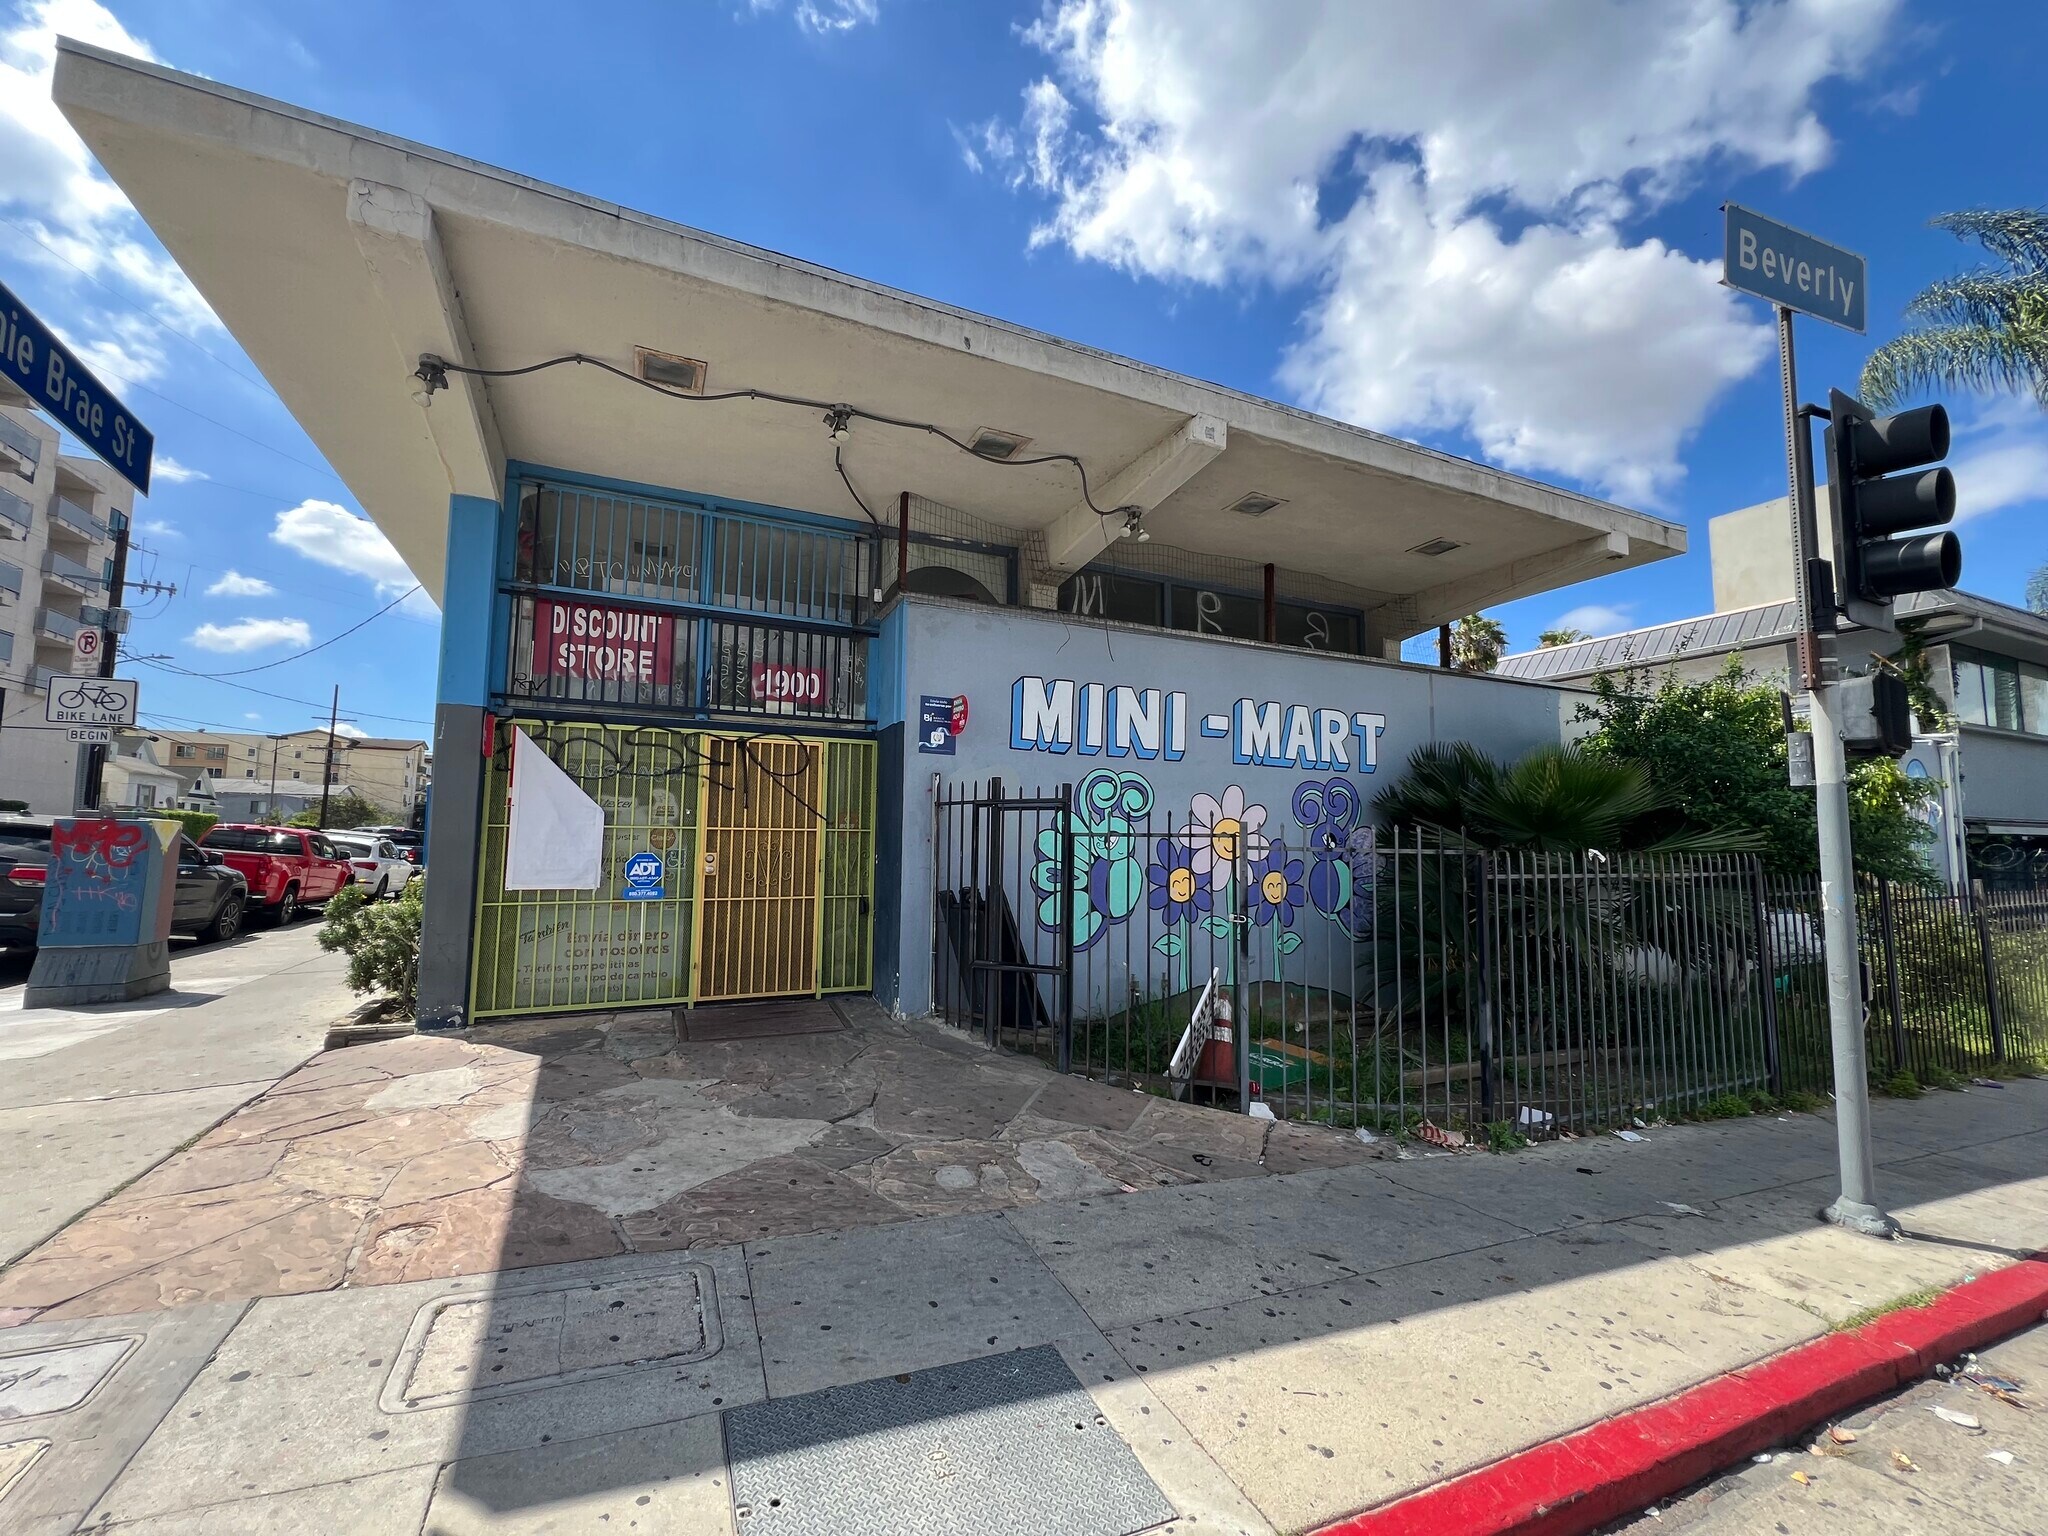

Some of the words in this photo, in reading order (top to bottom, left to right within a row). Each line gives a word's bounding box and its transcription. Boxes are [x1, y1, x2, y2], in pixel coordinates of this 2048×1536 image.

[1739, 228, 1854, 316] Beverly
[46, 349, 104, 438] Brae
[112, 415, 135, 467] St
[553, 605, 662, 643] DISCOUNT
[558, 642, 653, 676] STORE
[760, 668, 820, 699] 1900
[57, 711, 86, 720] BIKE
[92, 713, 124, 723] LANE
[1009, 676, 1187, 762] MINI
[70, 730, 108, 740] BEGIN
[629, 862, 660, 876] ADT
[566, 960, 640, 972] compeitias
